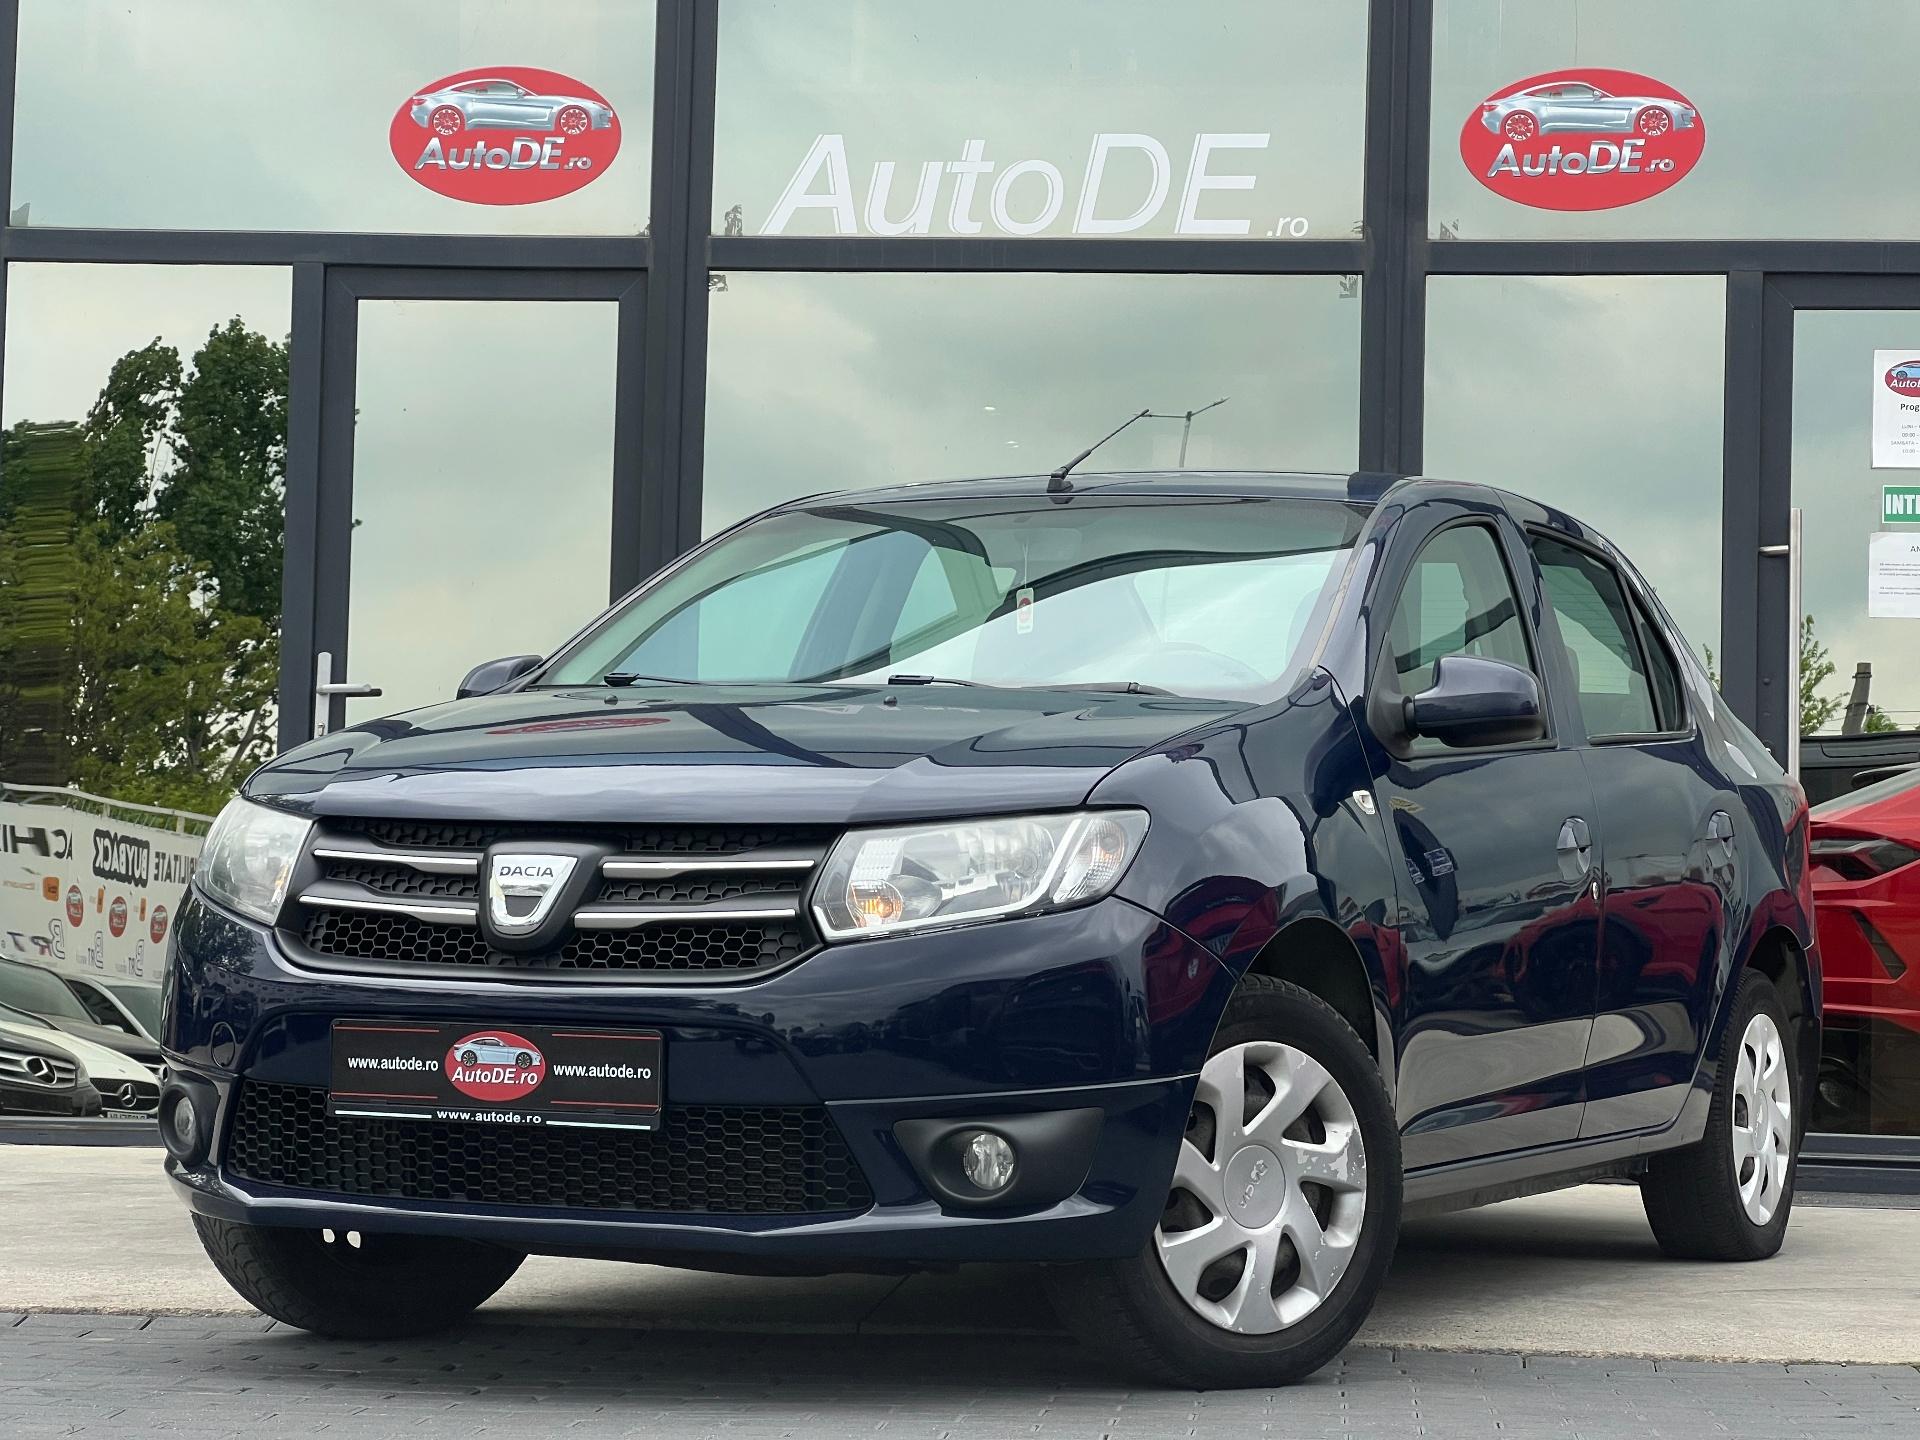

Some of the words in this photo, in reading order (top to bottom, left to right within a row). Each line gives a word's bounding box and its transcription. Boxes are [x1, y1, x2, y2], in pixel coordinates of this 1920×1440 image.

[1891, 378, 1920, 388] Auto
[500, 866, 554, 878] DACIA
[347, 1056, 439, 1072] www.autode.ro
[553, 1063, 652, 1079] www.autode.ro
[451, 1066, 538, 1085] AutoDE.ro
[436, 1110, 542, 1124] www.autode.ro
